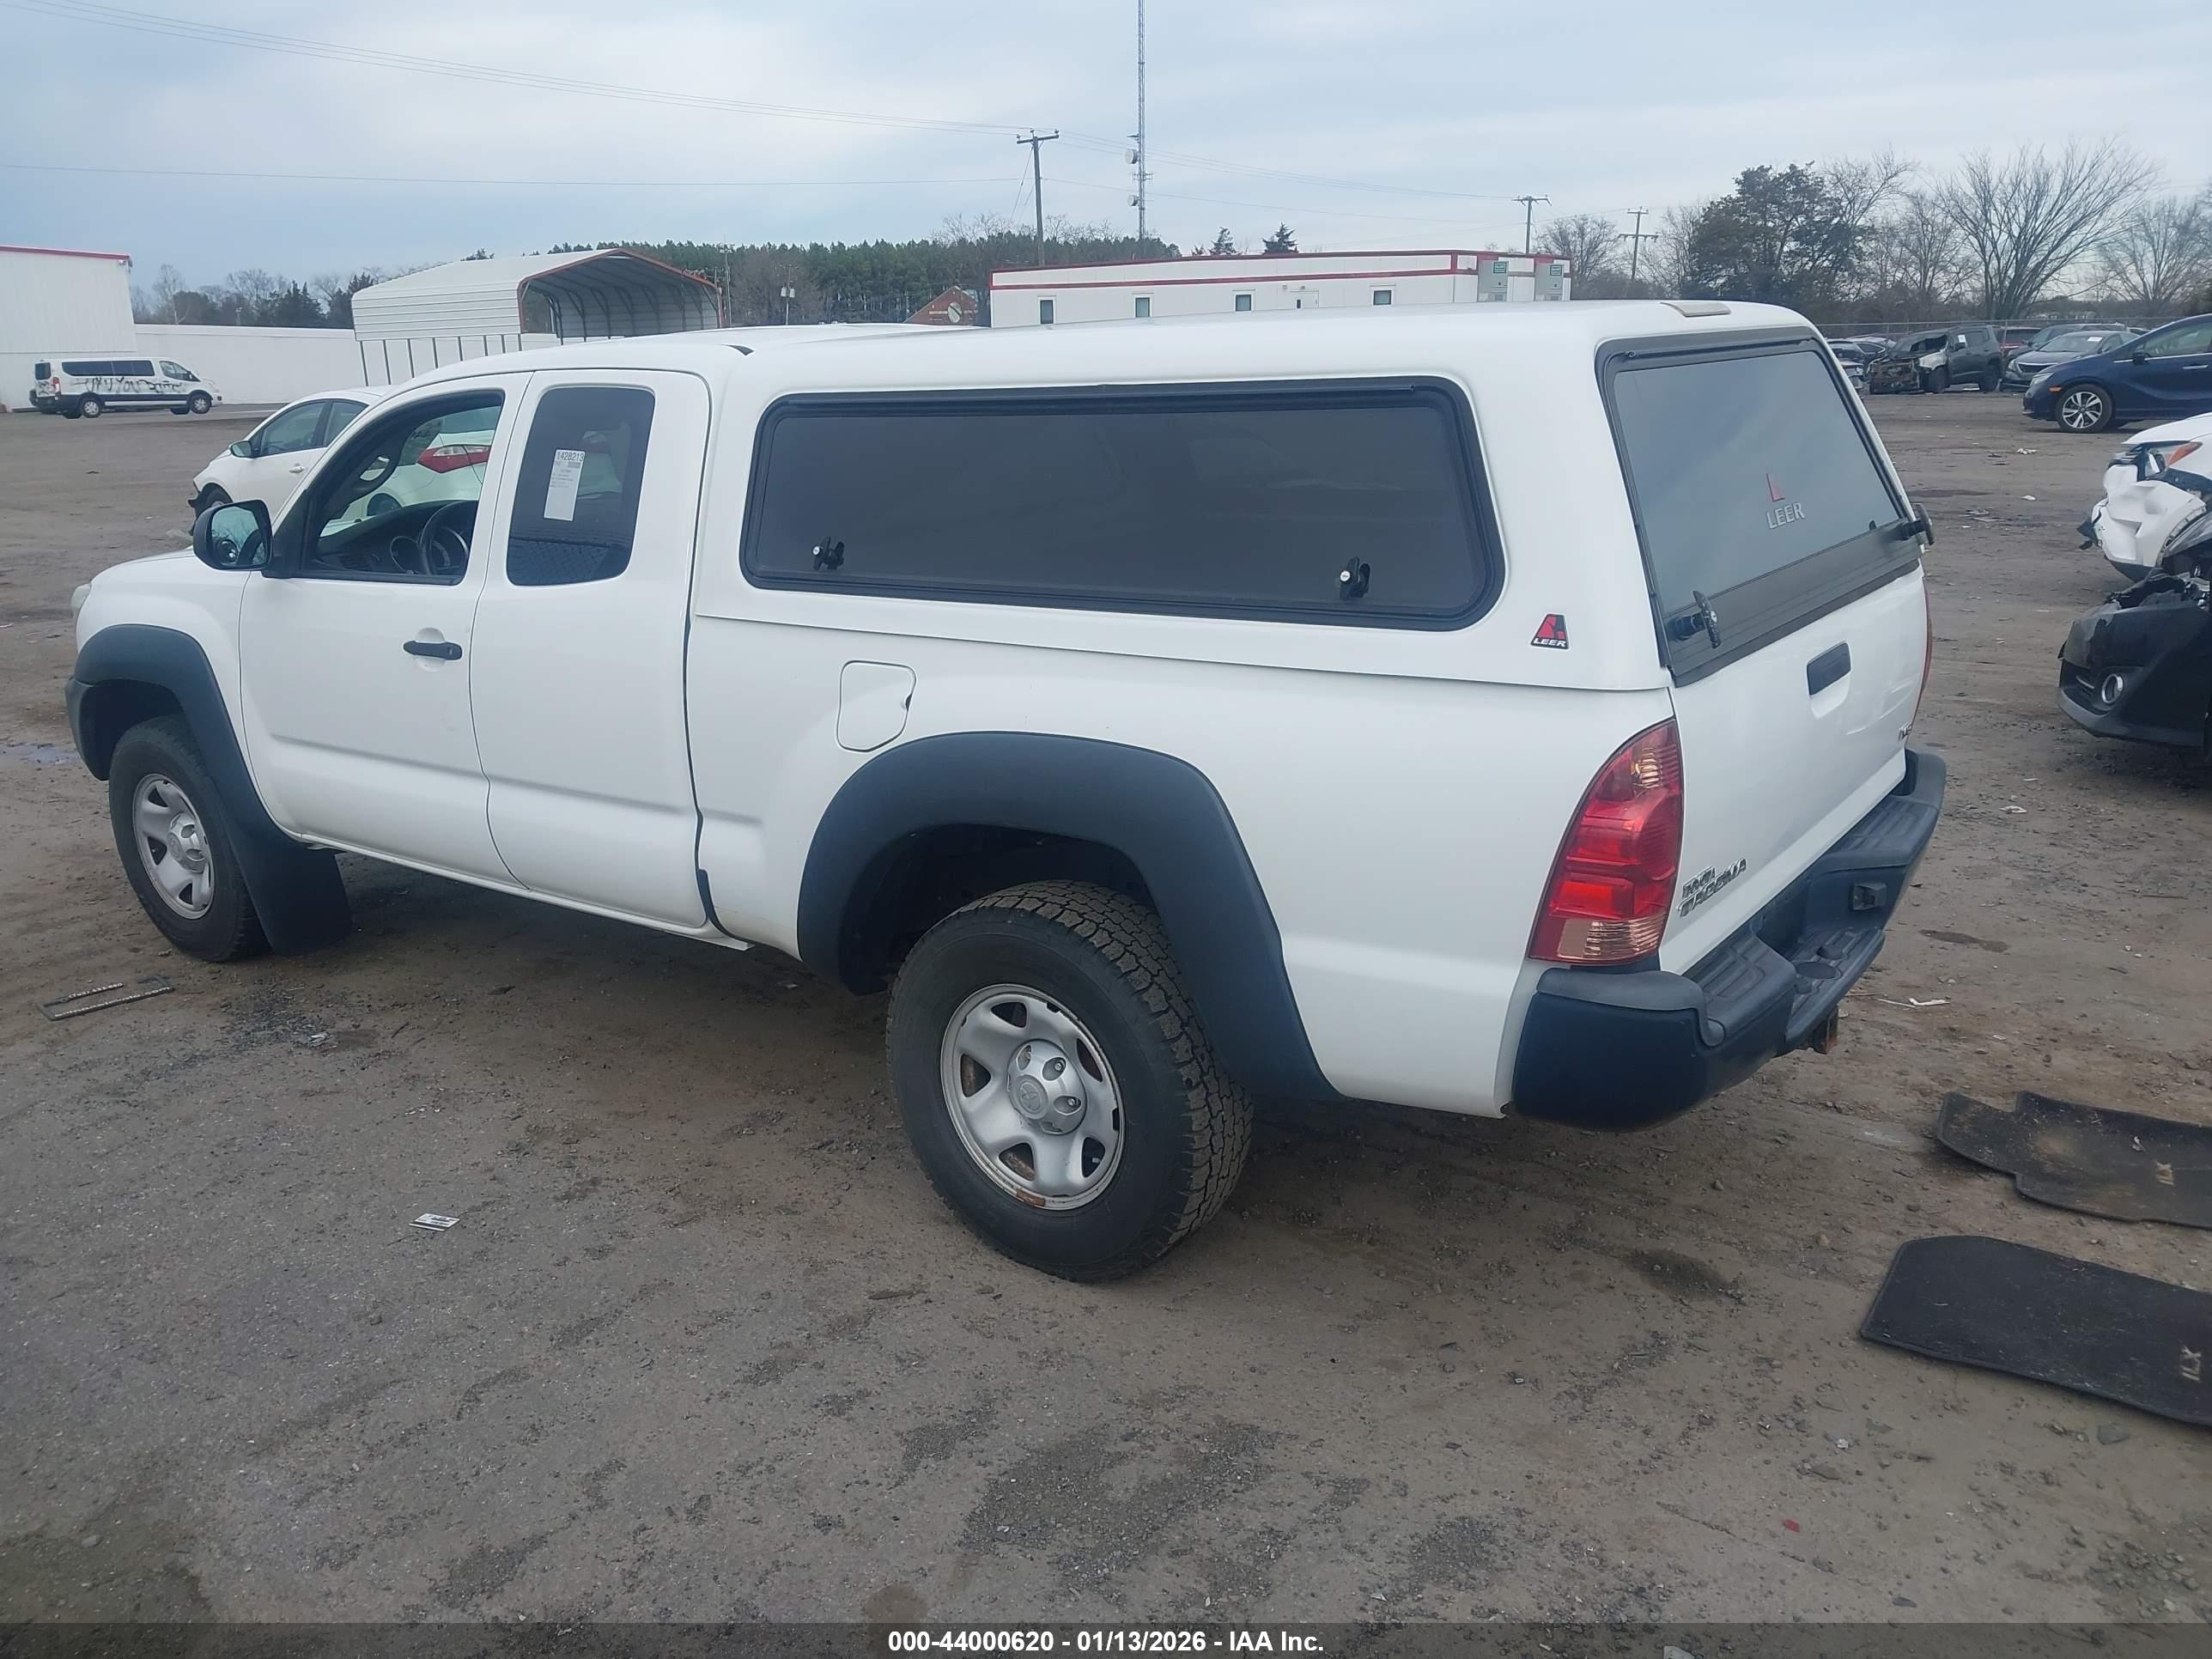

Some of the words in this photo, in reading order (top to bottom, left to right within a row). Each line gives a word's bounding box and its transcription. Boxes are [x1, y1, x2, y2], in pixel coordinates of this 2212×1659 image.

[1765, 502, 1806, 529] LEER
[1533, 637, 1567, 647] LEER
[1676, 858, 1747, 918] TACOMA
[2182, 1346, 2202, 1382] ILX
